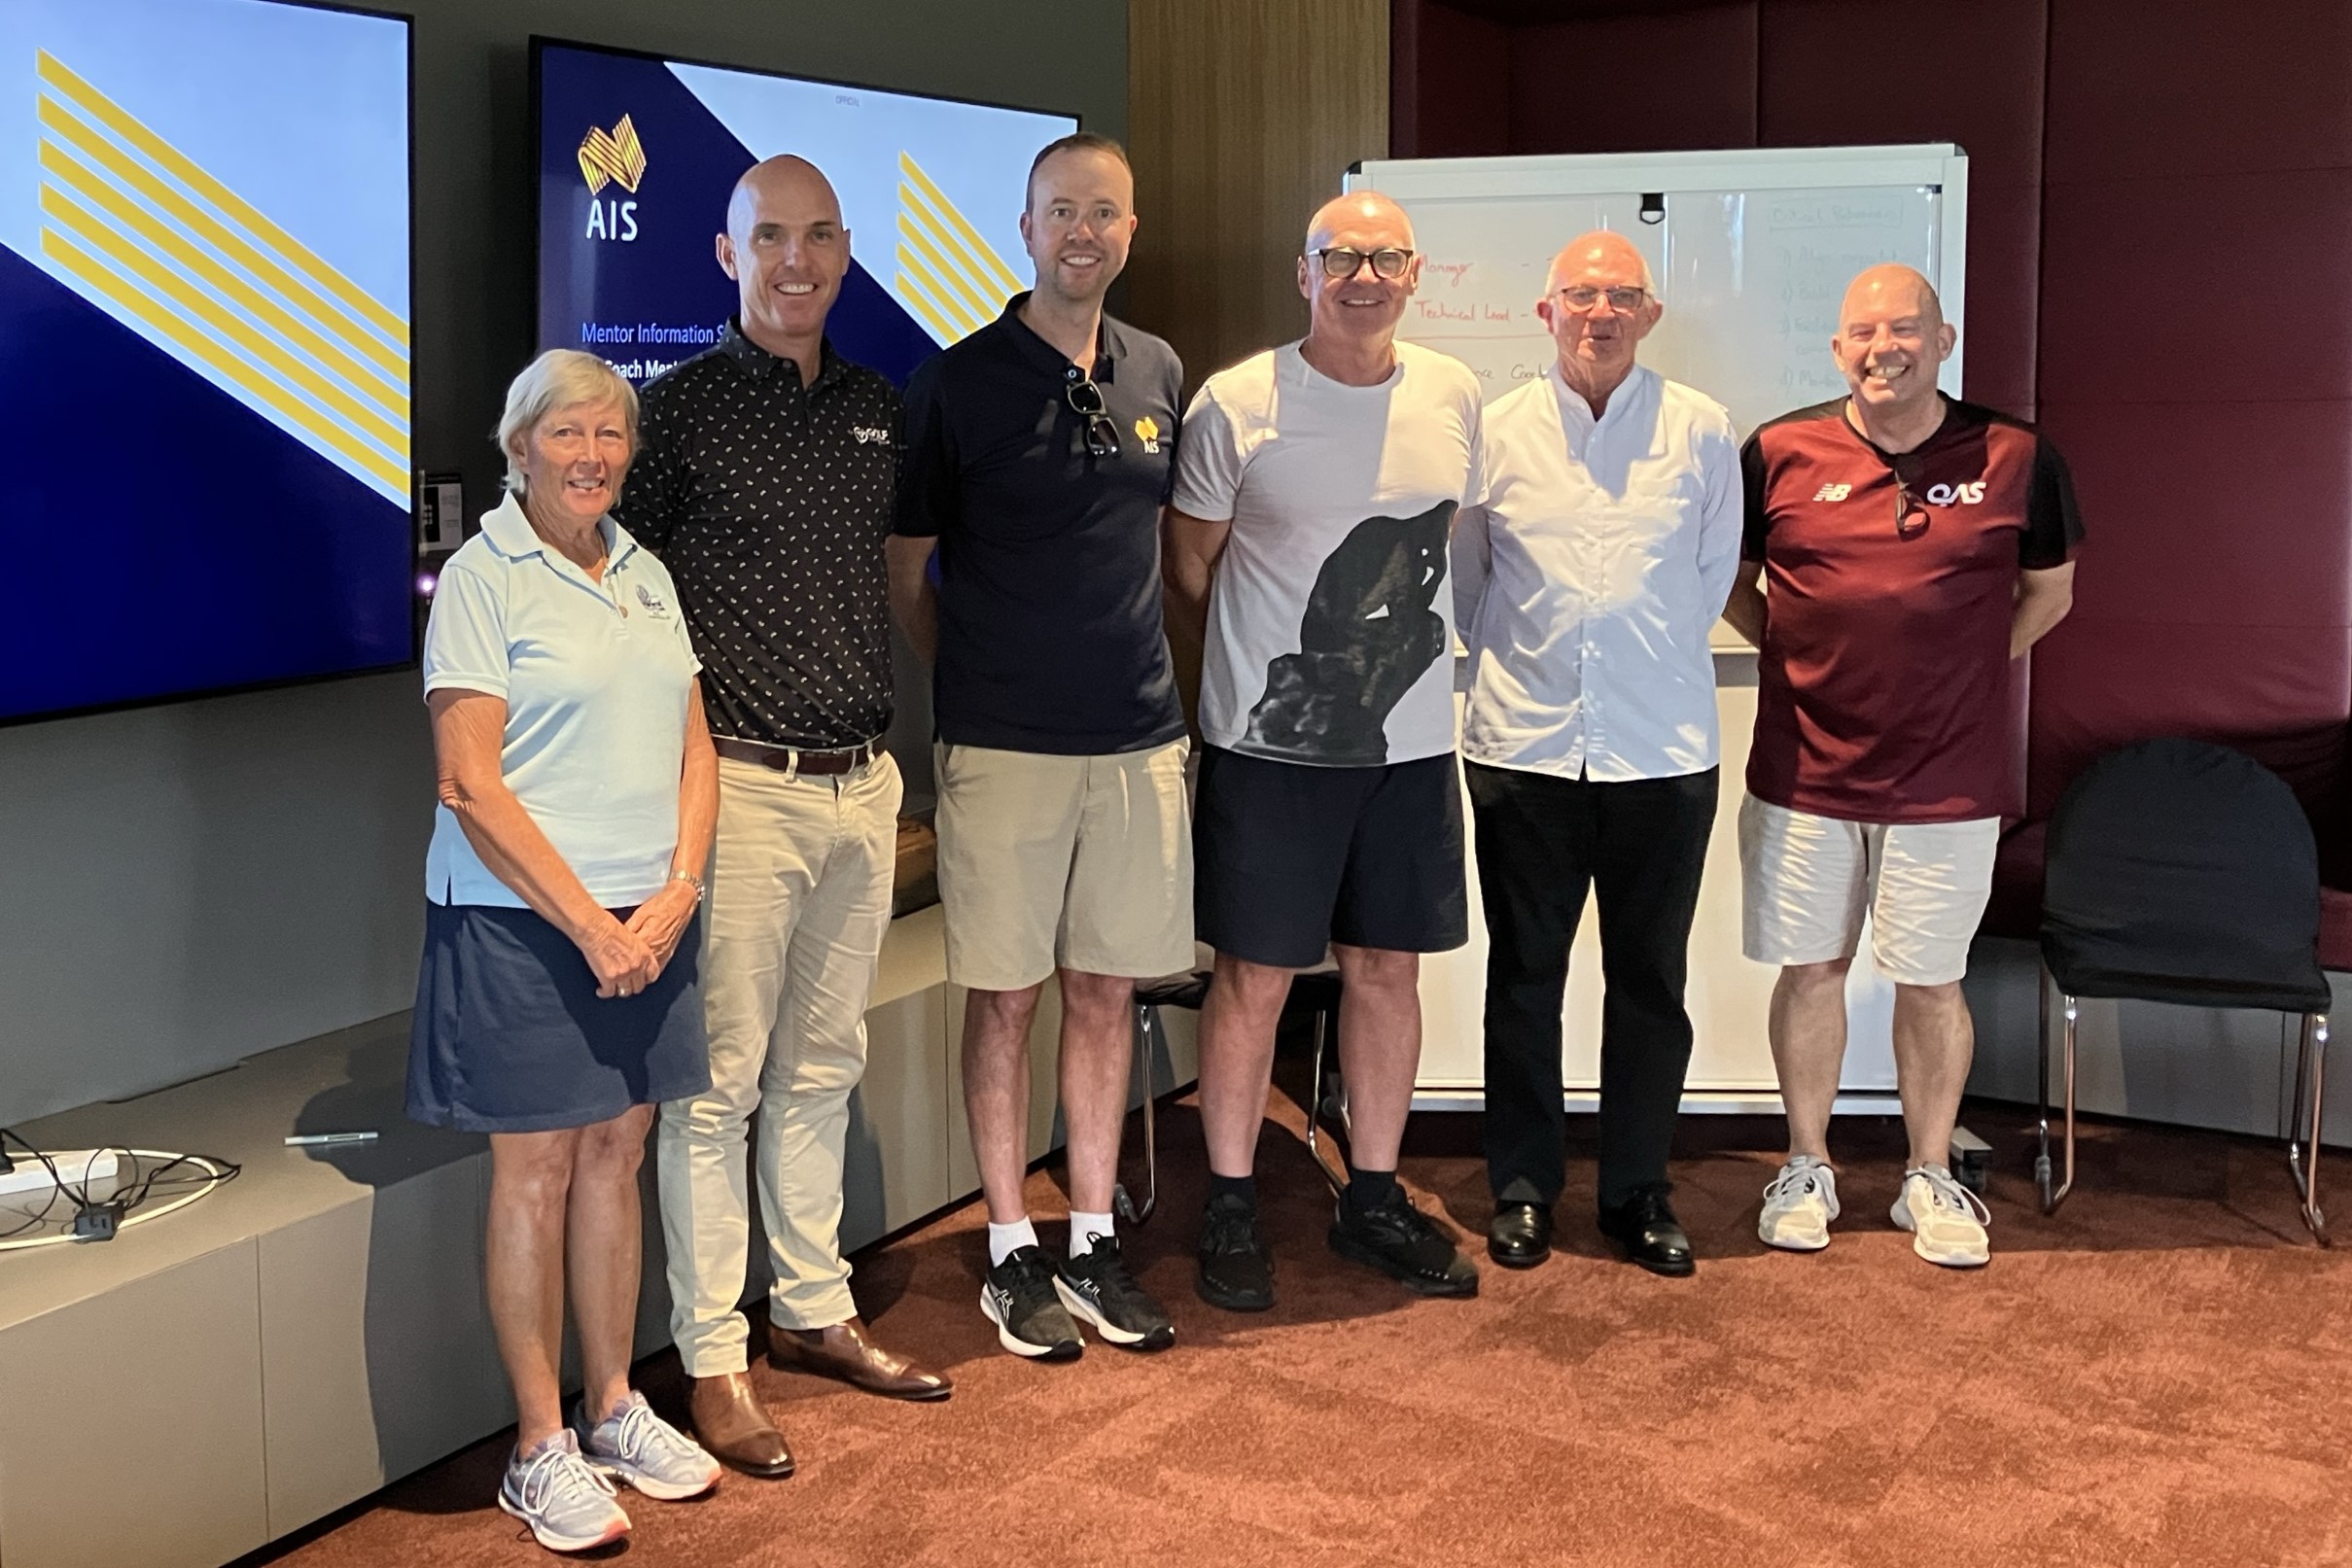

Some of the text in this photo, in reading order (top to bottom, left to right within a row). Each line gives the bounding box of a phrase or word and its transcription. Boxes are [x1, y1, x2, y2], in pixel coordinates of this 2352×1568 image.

[585, 198, 638, 242] AIS
[1415, 299, 1511, 324] Technical Lead
[582, 322, 635, 343] Mentor
[638, 323, 714, 344] Information
